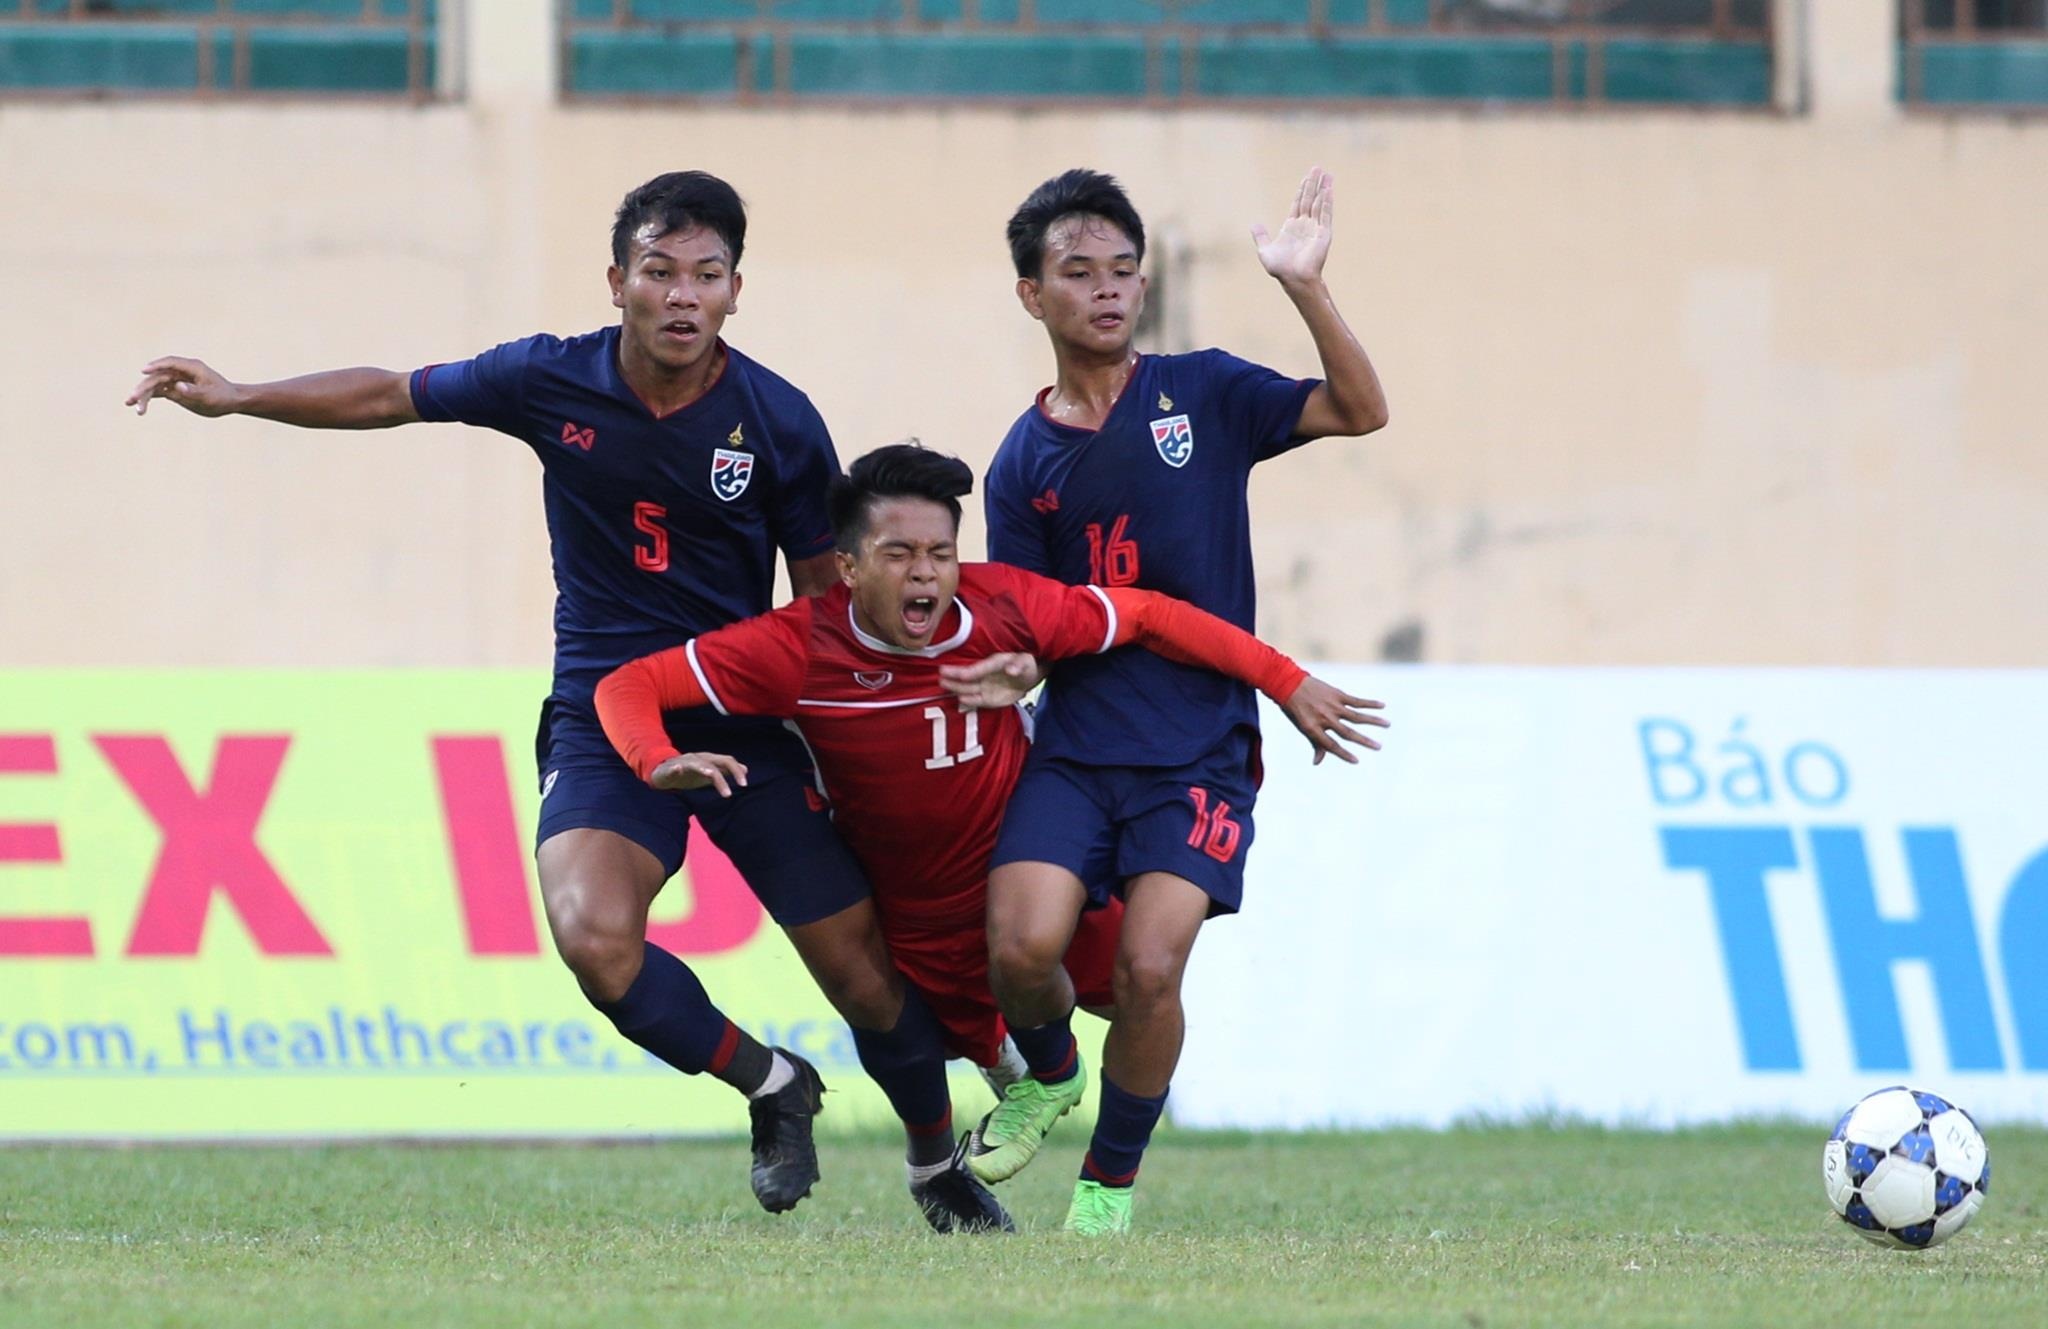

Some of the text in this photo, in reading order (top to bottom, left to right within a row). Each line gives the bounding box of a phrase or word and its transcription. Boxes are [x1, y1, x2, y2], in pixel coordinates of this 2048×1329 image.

[633, 501, 669, 573] 5
[1085, 514, 1140, 587] 16
[923, 705, 985, 771] 11
[1637, 714, 1851, 808] Báo
[1187, 786, 1240, 864] 16
[0, 1005, 618, 1073] om, Healthcare,
